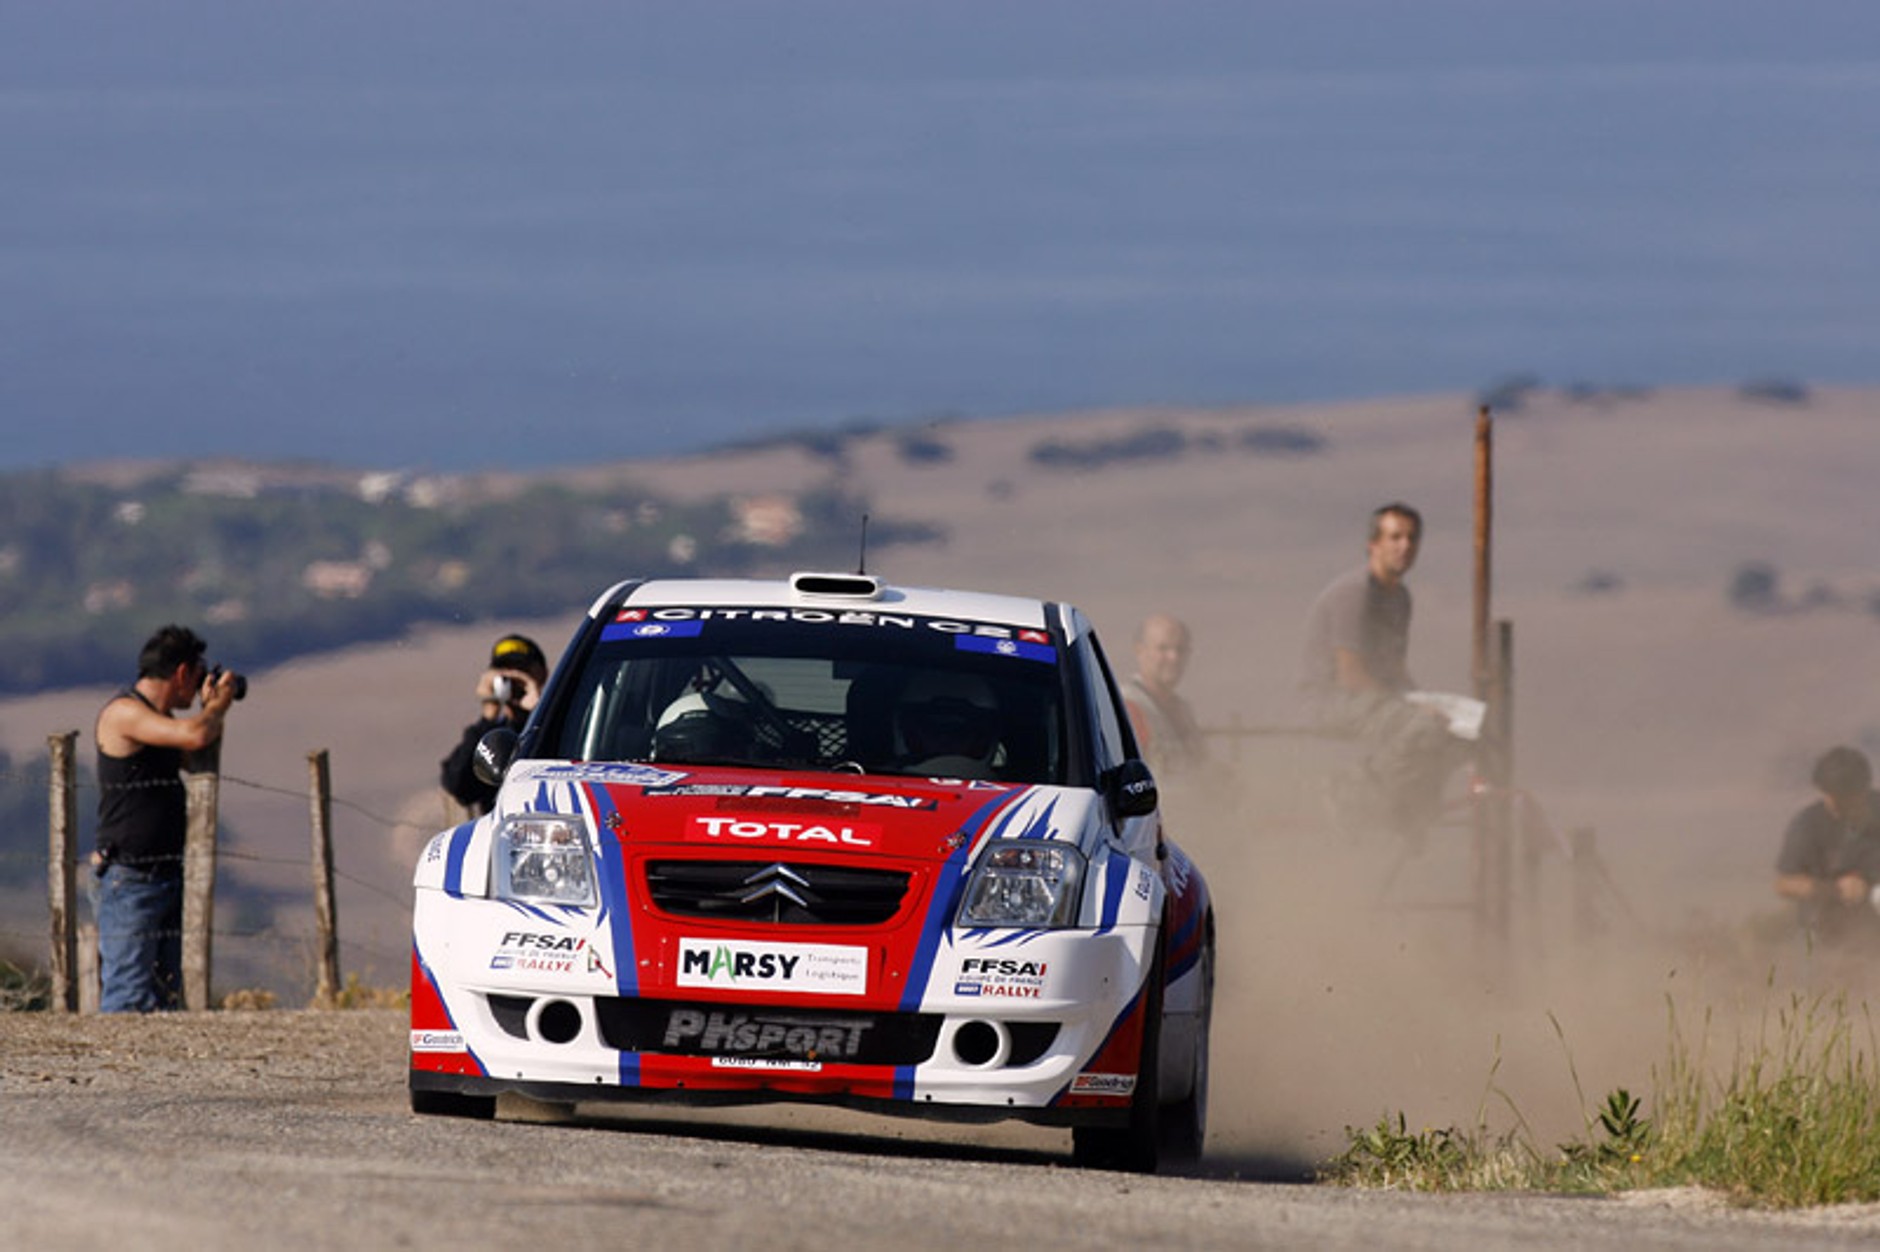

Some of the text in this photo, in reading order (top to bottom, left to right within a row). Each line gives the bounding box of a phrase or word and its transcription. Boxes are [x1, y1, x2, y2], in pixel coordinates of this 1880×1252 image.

[696, 818, 871, 846] TOTAL
[500, 932, 573, 951] FFSA
[517, 959, 574, 973] RALLYE
[683, 945, 799, 983] MARSY
[961, 958, 1038, 976] FFSA
[982, 984, 1041, 998] RALLYE
